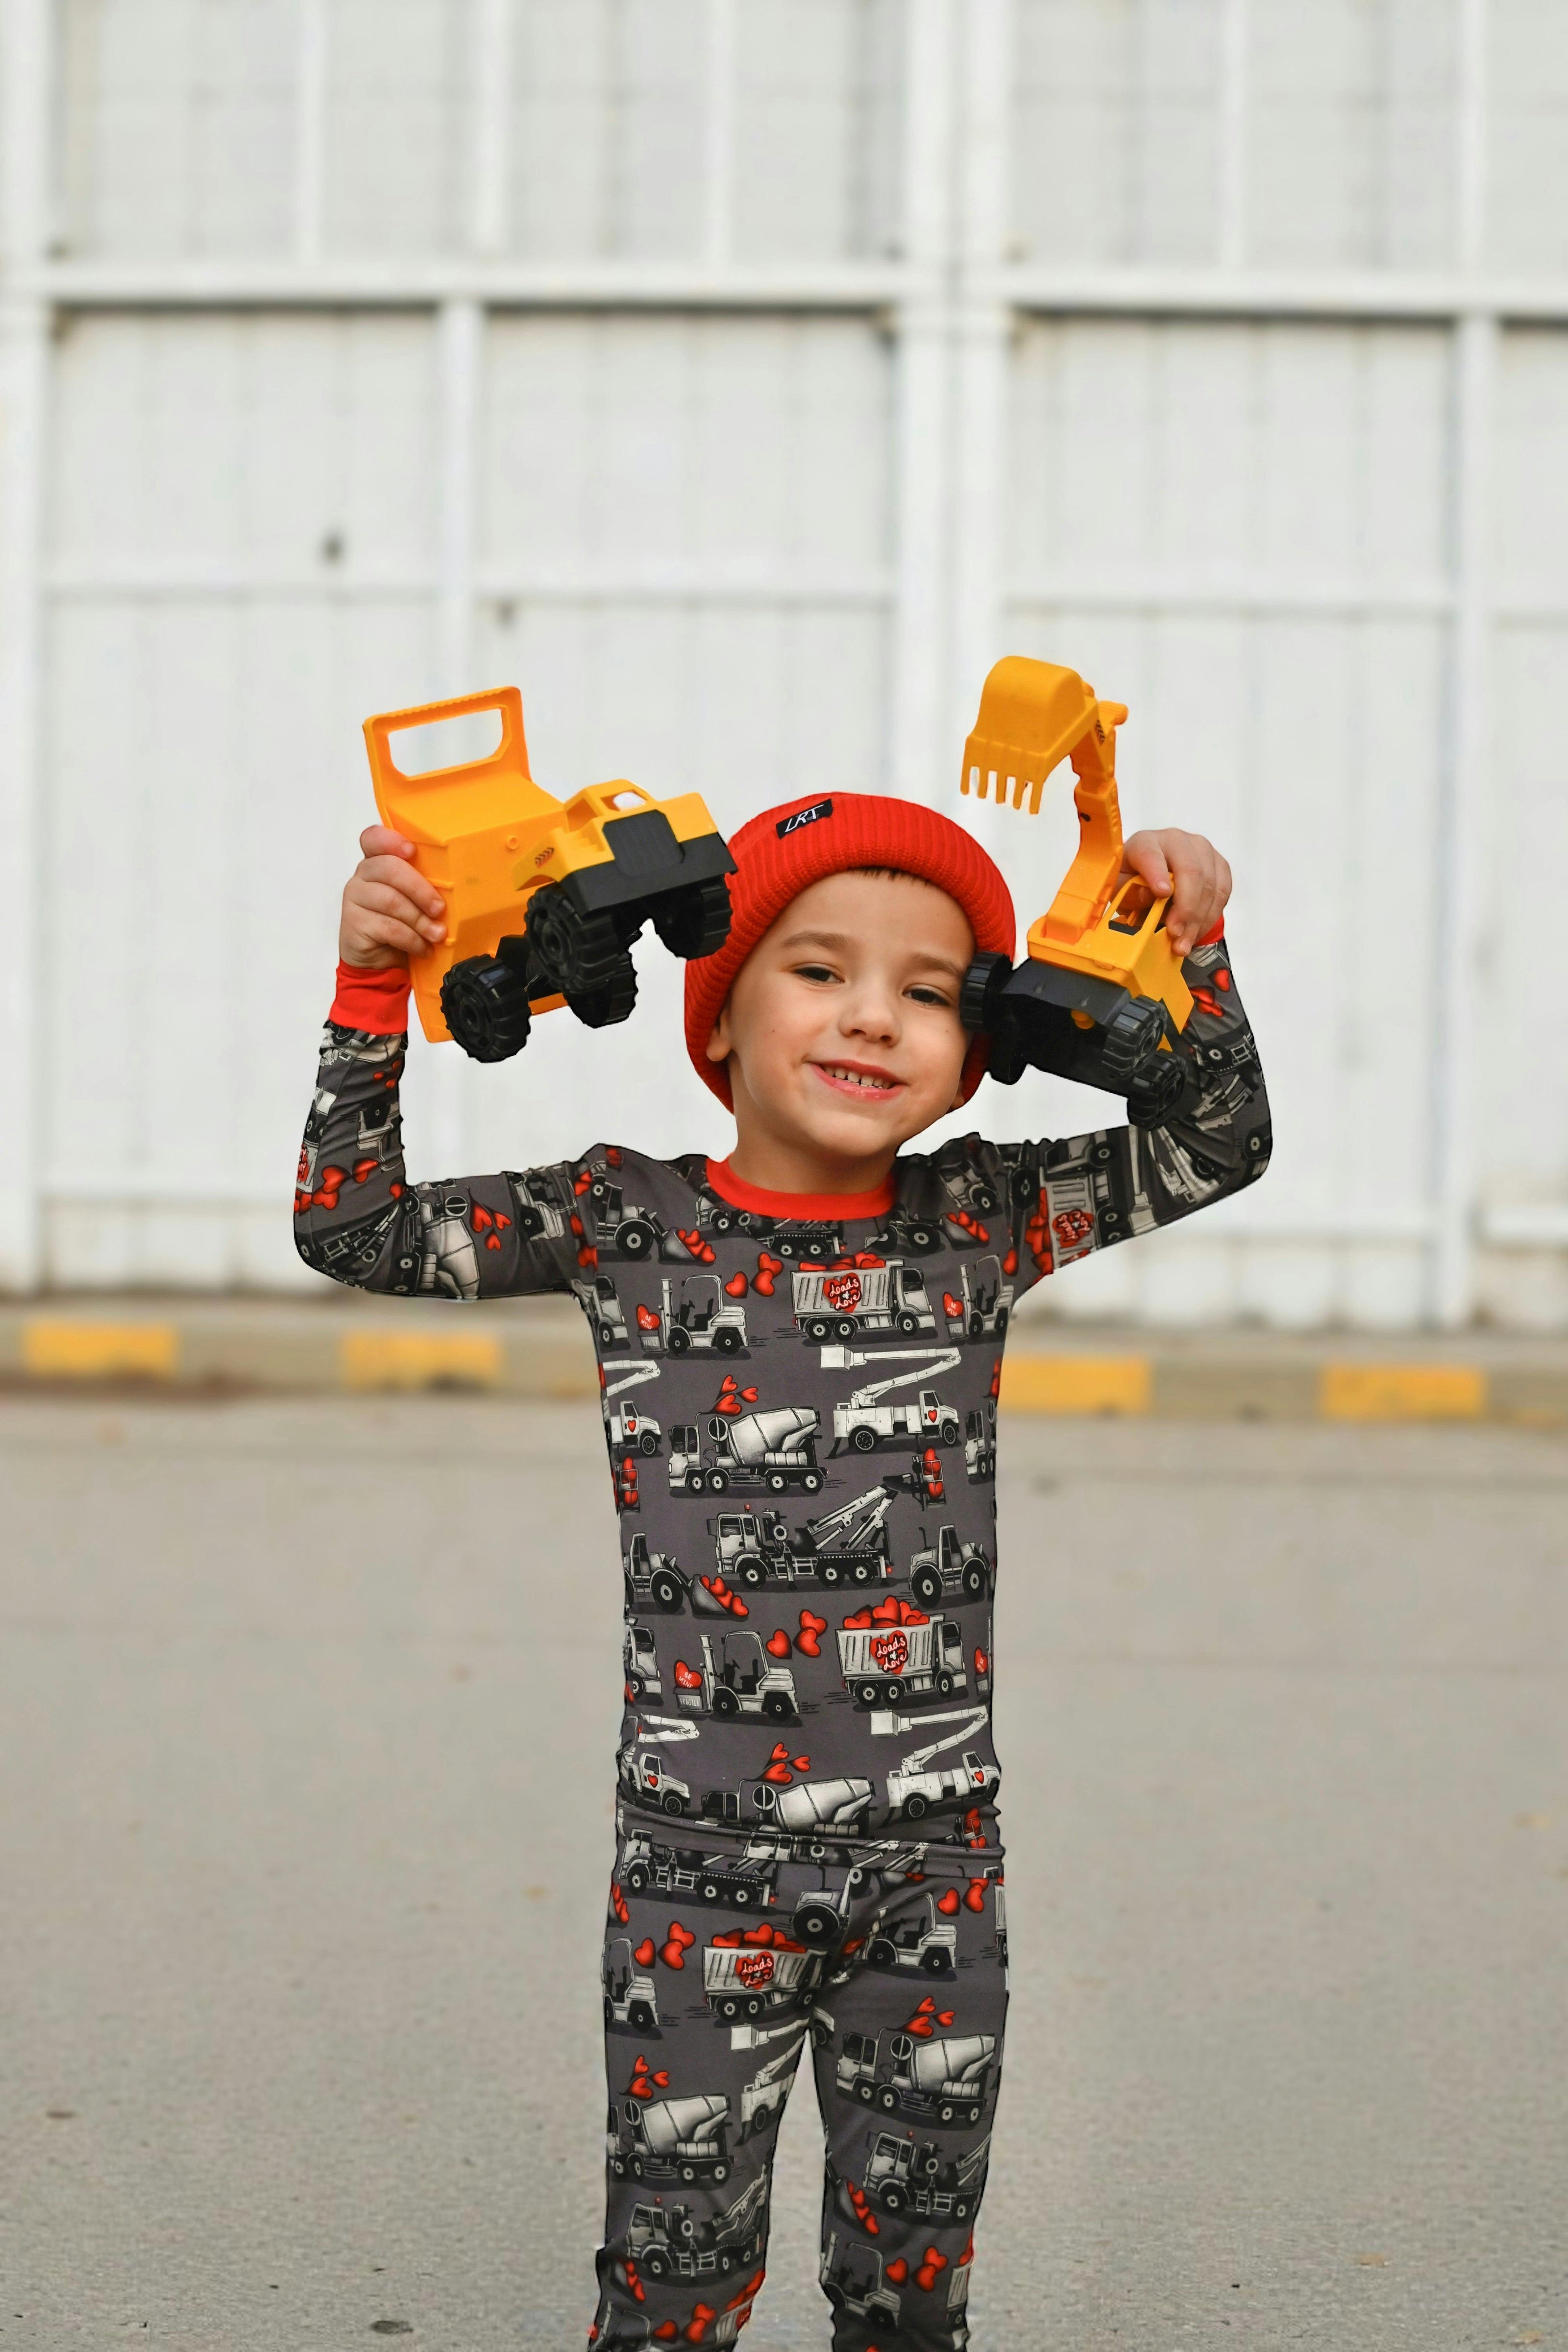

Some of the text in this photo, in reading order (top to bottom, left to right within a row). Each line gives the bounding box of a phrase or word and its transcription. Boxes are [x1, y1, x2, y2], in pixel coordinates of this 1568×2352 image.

[784, 804, 824, 833] LRT
[830, 1278, 859, 1297] Loads
[835, 1291, 860, 1309] Love
[877, 1637, 906, 1657] Loads
[883, 1650, 907, 1670] Love
[684, 1671, 692, 1680] BE
[680, 1698, 700, 1706] FRAGILE
[741, 1958, 772, 1975] Loads
